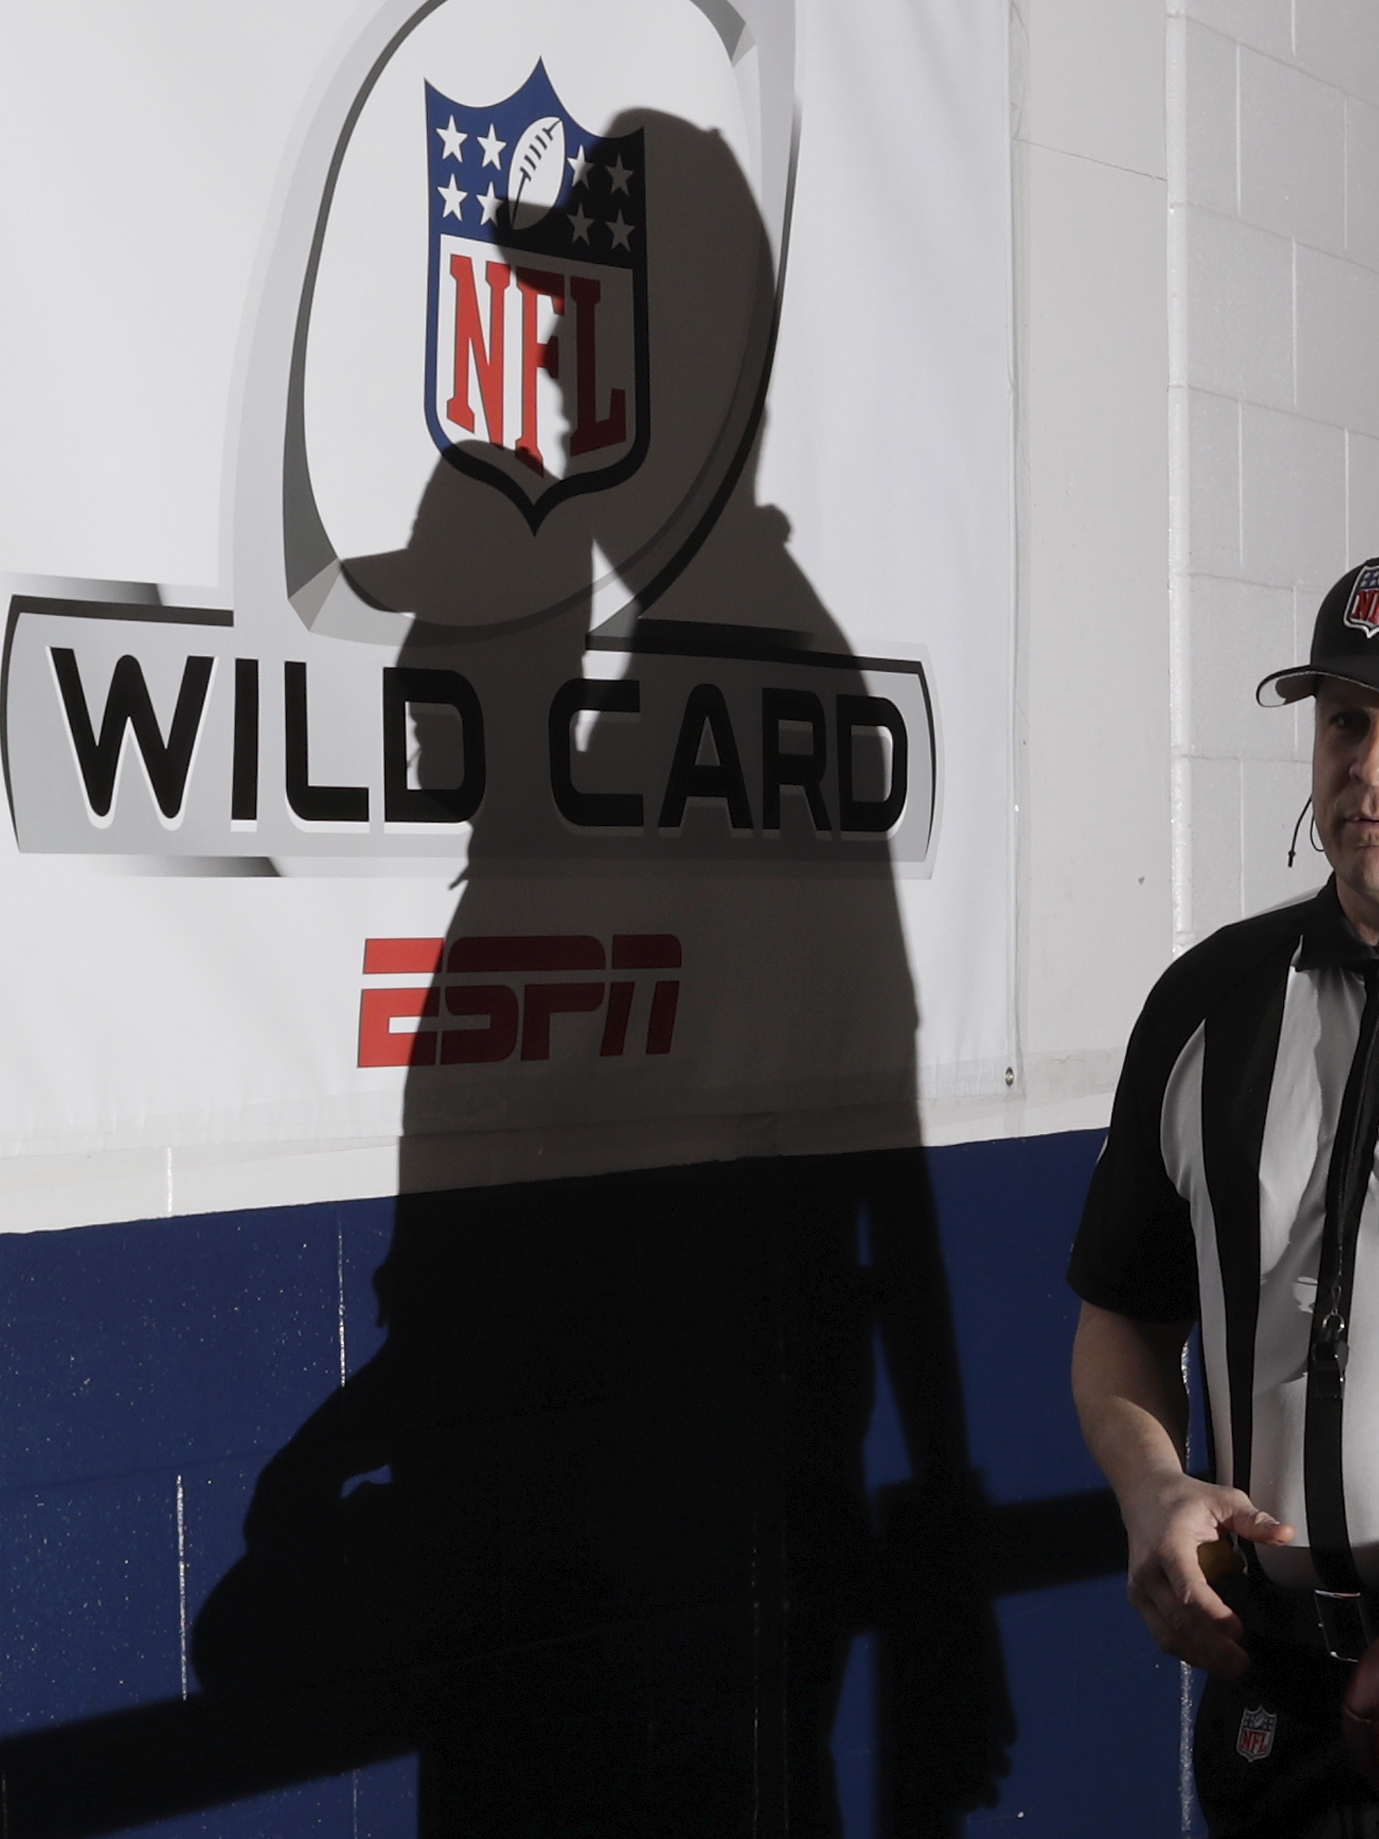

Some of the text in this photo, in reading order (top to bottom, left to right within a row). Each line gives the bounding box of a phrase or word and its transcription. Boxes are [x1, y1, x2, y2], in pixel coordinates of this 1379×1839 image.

[447, 253, 628, 478] NFL
[47, 646, 910, 835] WILD CARD
[357, 934, 682, 1068] ESPN
[1240, 1729, 1267, 1755] NFL
